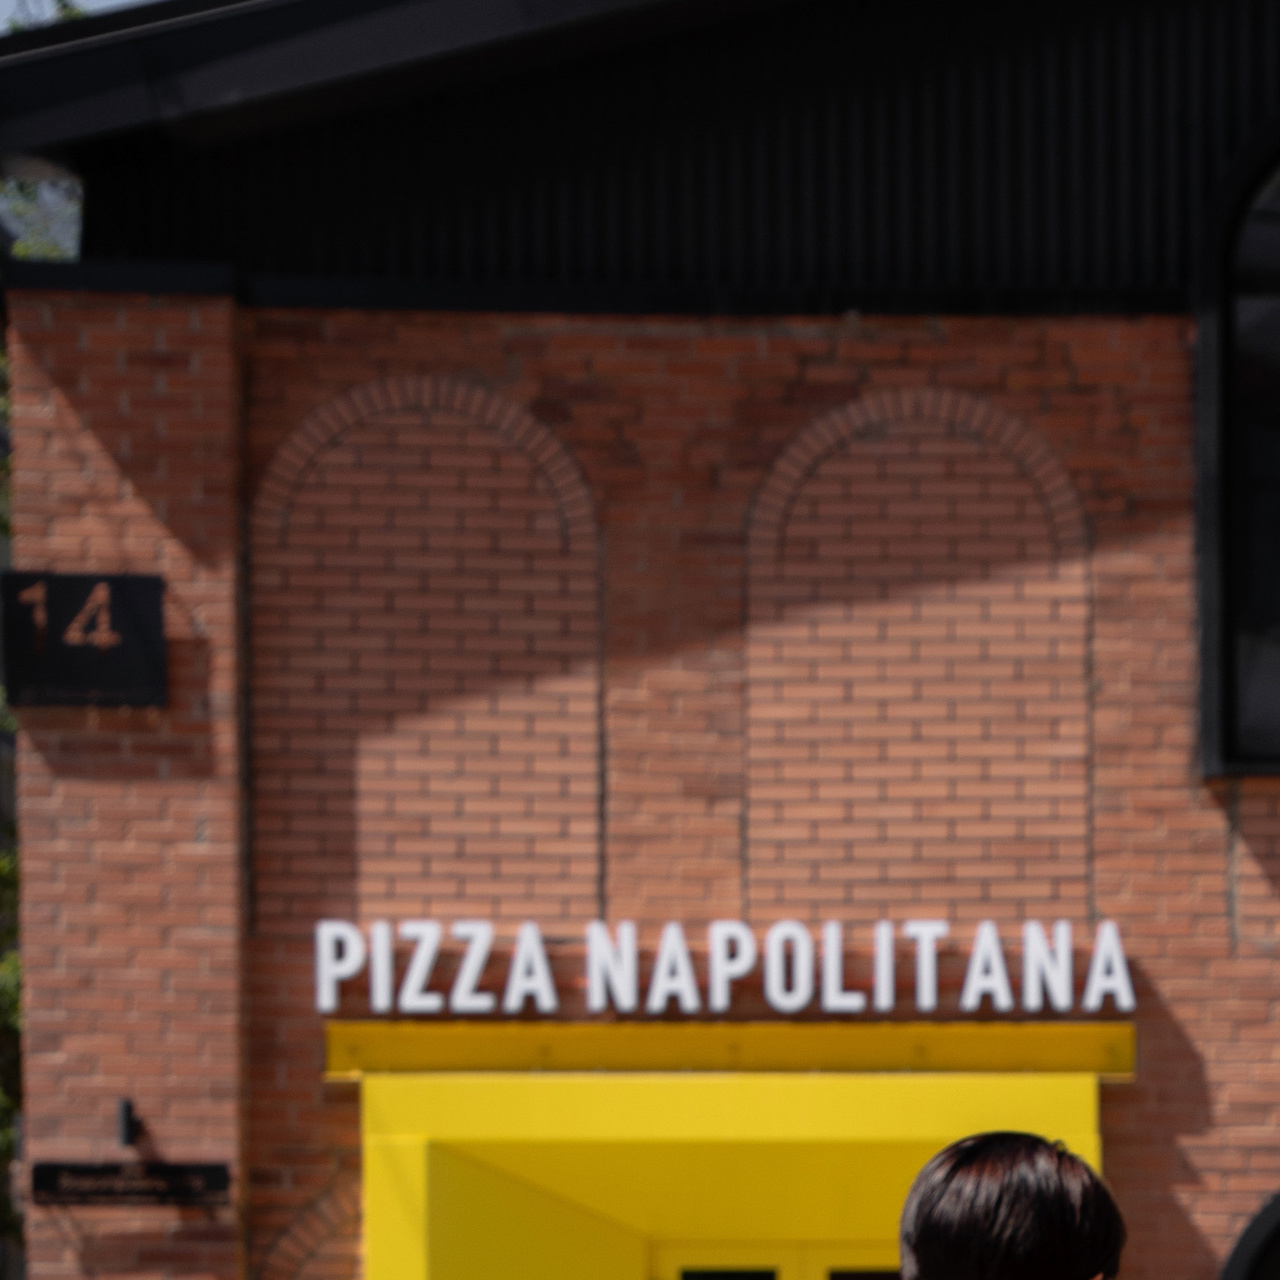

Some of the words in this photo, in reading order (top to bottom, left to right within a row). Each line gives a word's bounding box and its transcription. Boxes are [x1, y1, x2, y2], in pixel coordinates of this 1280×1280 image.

[17, 580, 122, 655] 14
[316, 920, 558, 1012] PIZZA
[586, 919, 1137, 1012] NAPOLITANA
